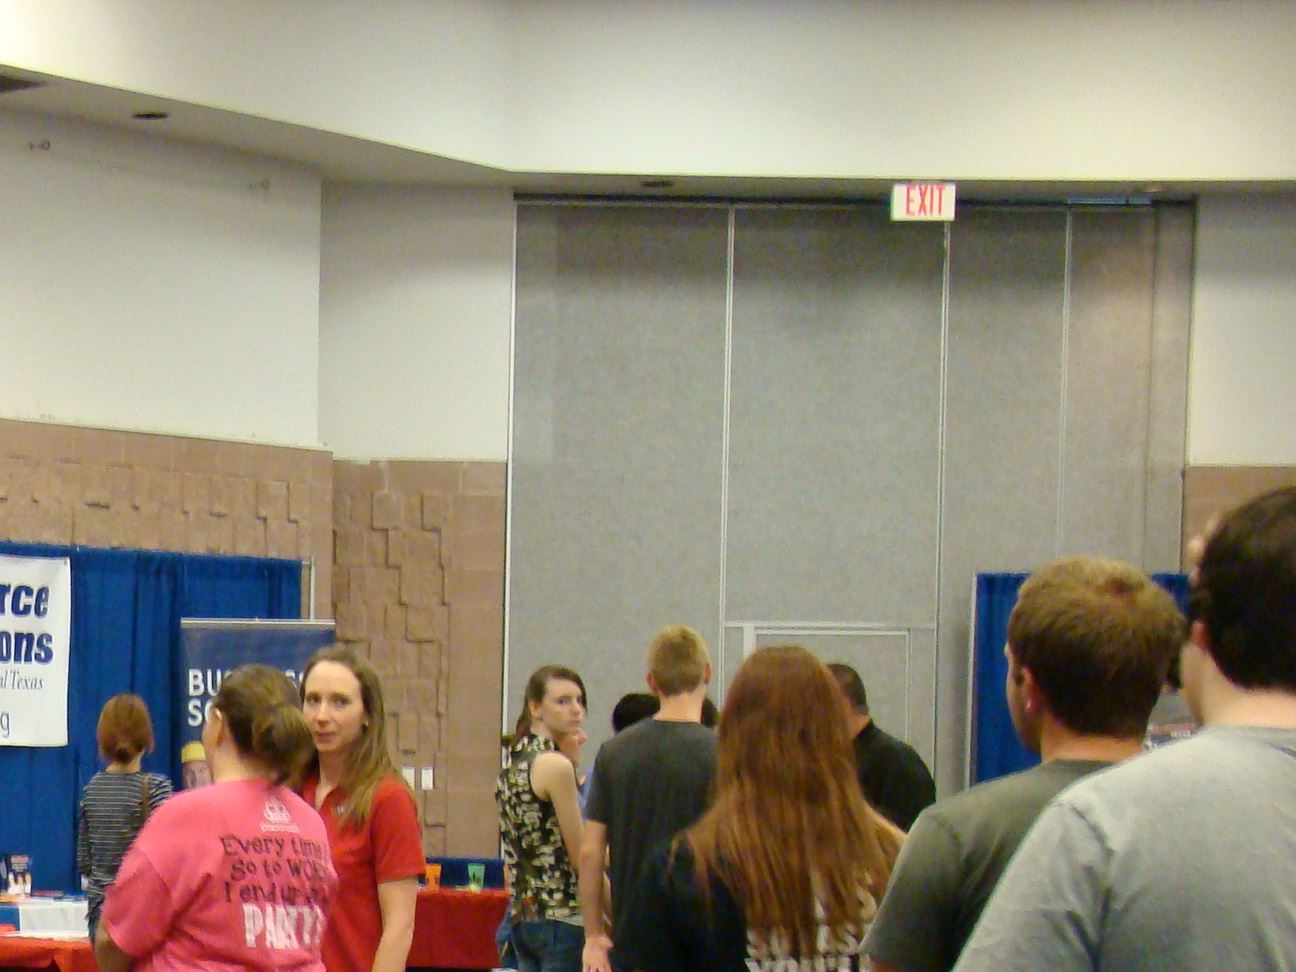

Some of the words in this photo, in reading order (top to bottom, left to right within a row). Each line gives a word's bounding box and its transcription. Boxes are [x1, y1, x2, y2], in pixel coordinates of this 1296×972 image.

[906, 183, 945, 216] EXIT
[9, 670, 44, 690] Texas
[220, 832, 285, 858] Every
[262, 858, 283, 878] to
[223, 880, 233, 903] I
[239, 881, 277, 903] end
